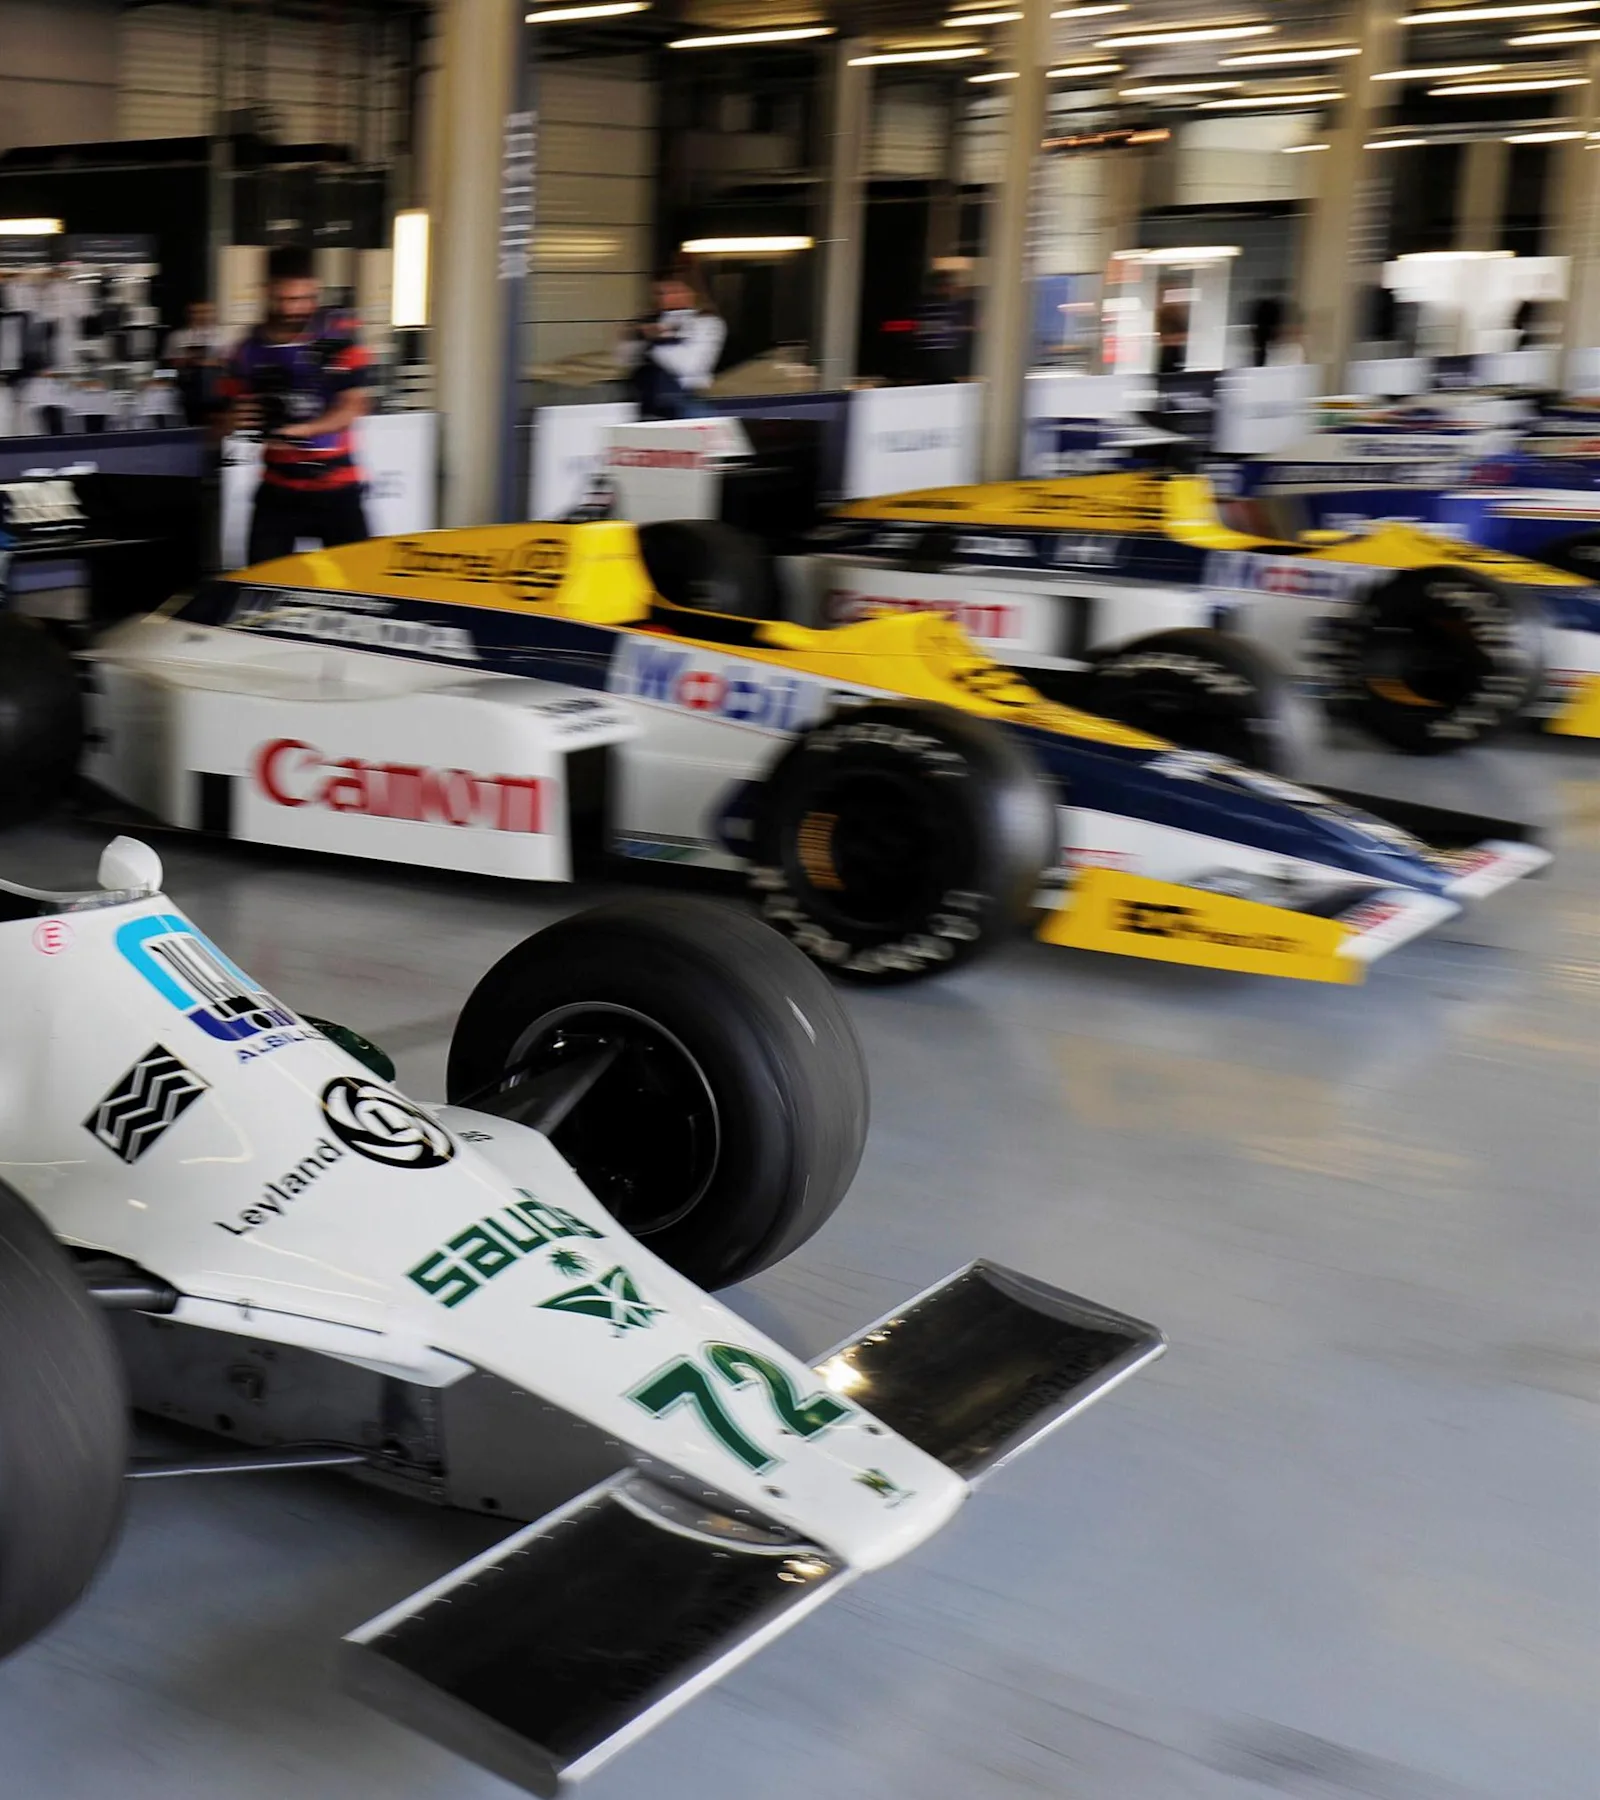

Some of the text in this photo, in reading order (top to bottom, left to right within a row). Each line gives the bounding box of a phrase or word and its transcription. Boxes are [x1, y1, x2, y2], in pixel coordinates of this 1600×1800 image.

[257, 738, 545, 835] Canon
[214, 1137, 347, 1236] Leyland
[404, 1187, 605, 1308] saudia
[620, 1340, 856, 1476] 72
